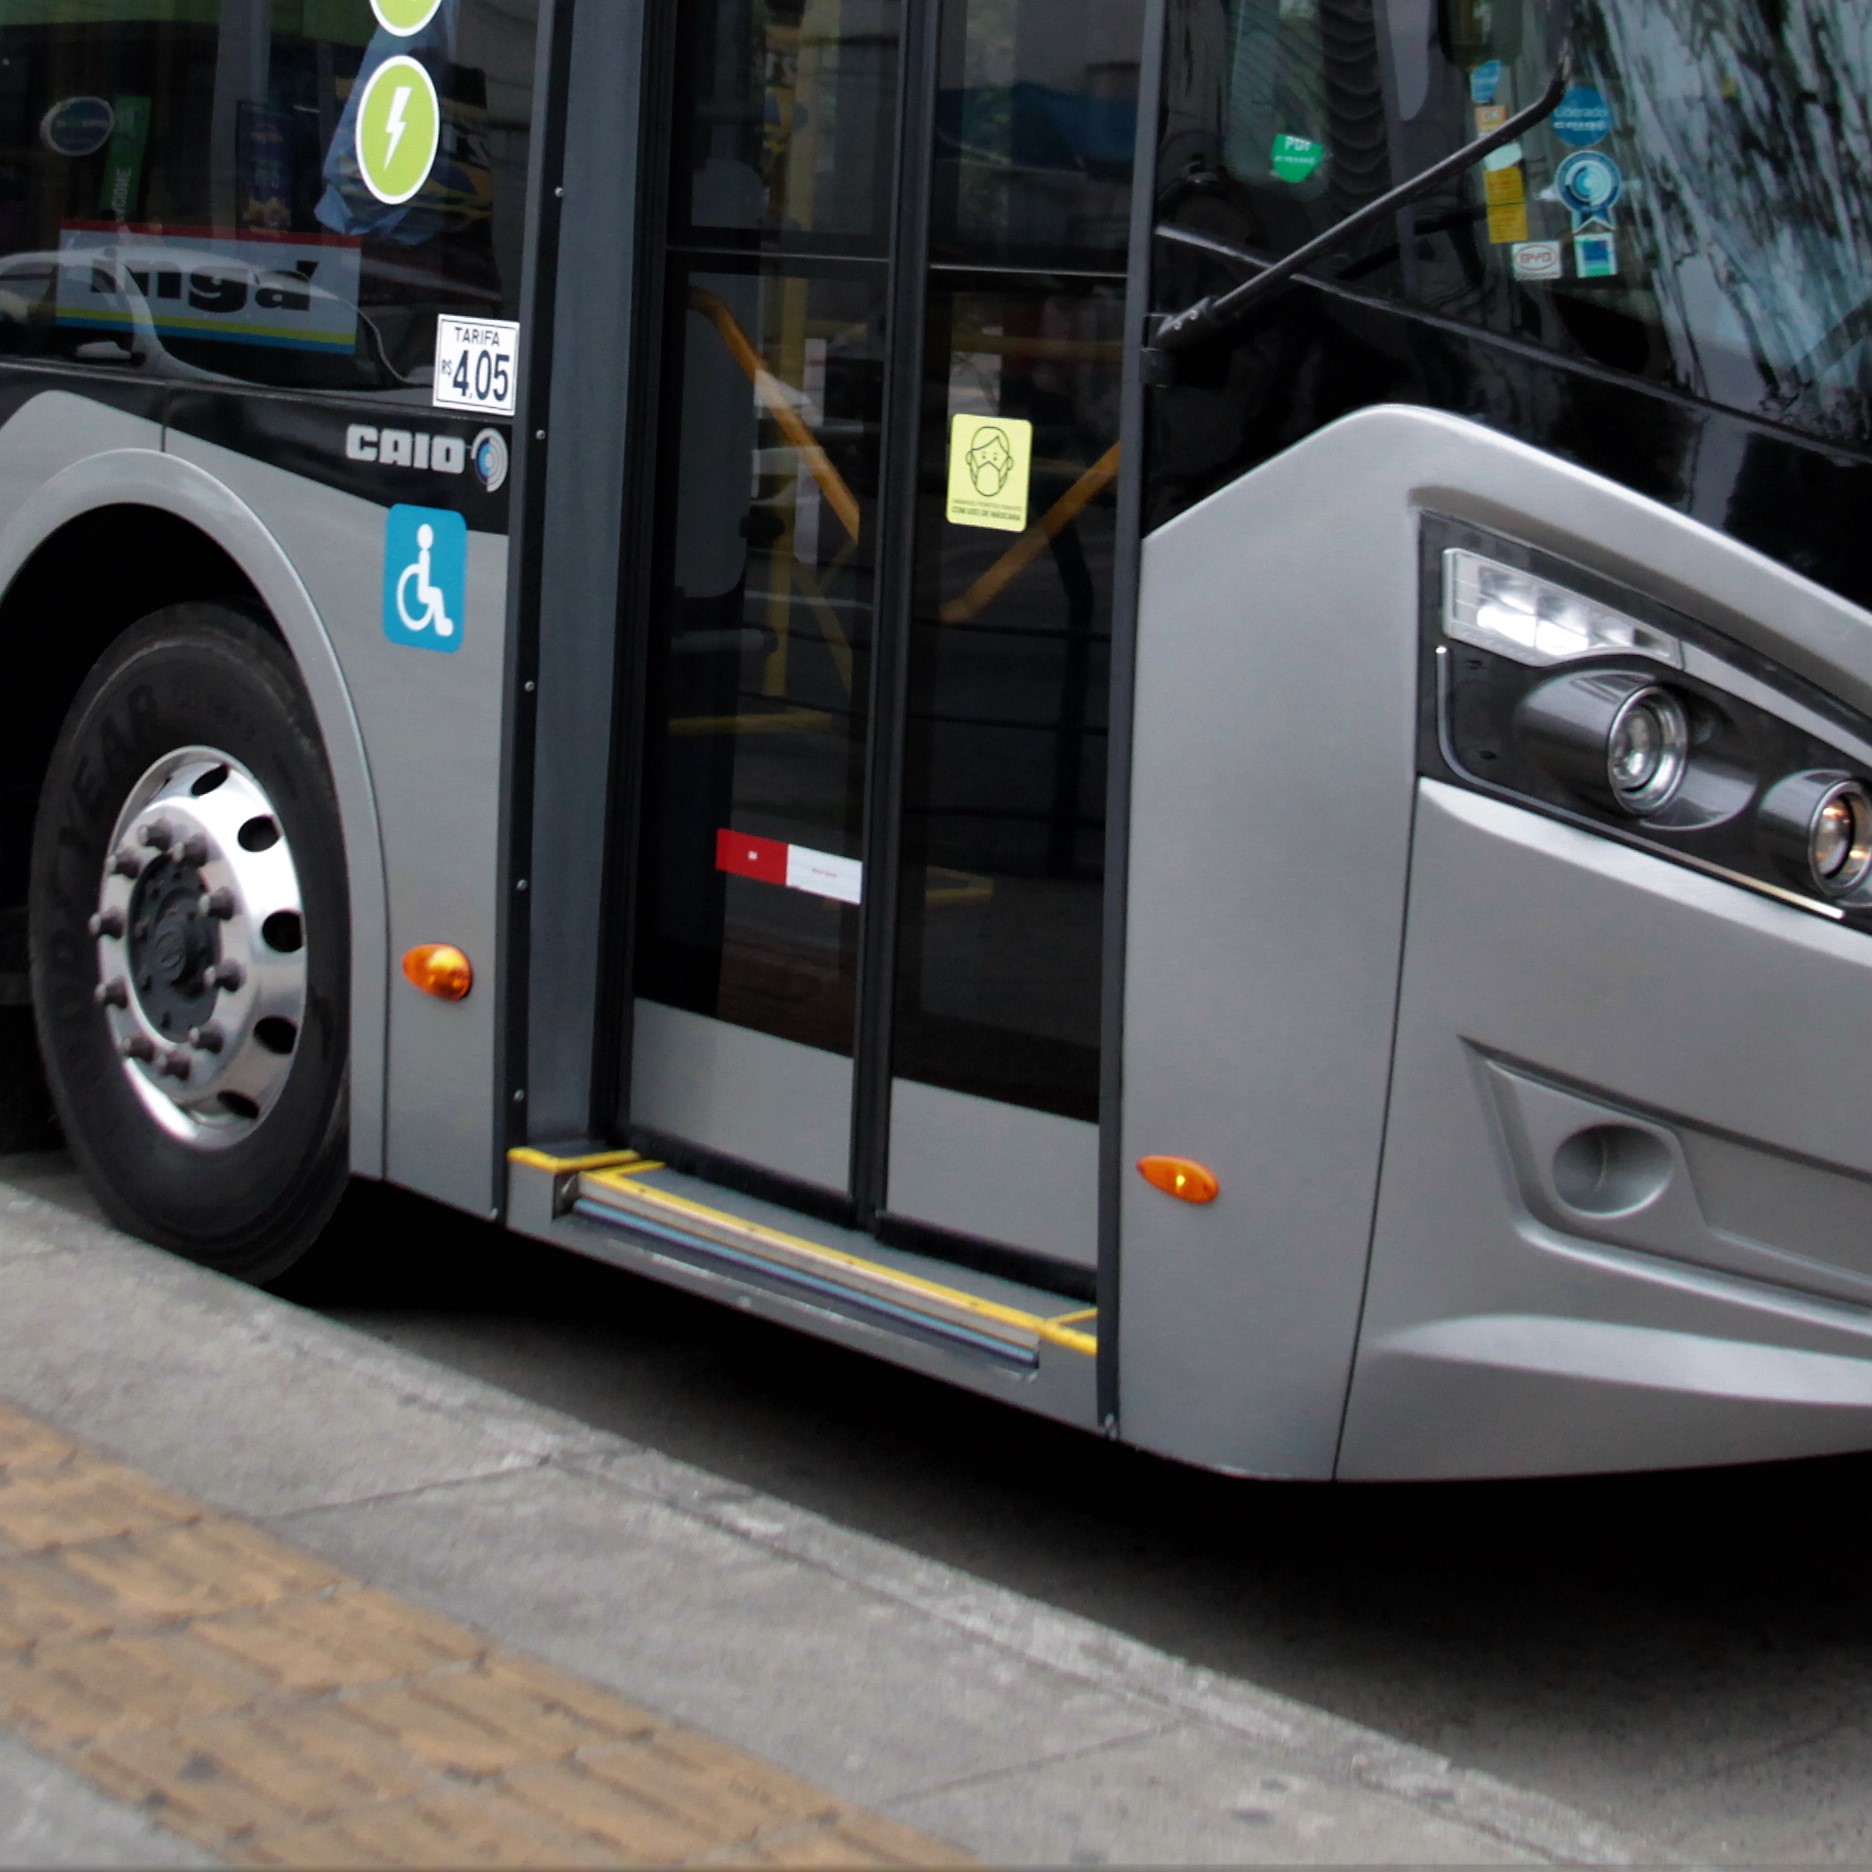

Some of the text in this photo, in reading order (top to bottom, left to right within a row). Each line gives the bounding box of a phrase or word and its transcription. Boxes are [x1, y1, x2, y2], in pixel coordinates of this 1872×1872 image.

[454, 326, 501, 347] TARIFA
[440, 349, 510, 402] R$ 4,05
[345, 423, 465, 474] CAIO
